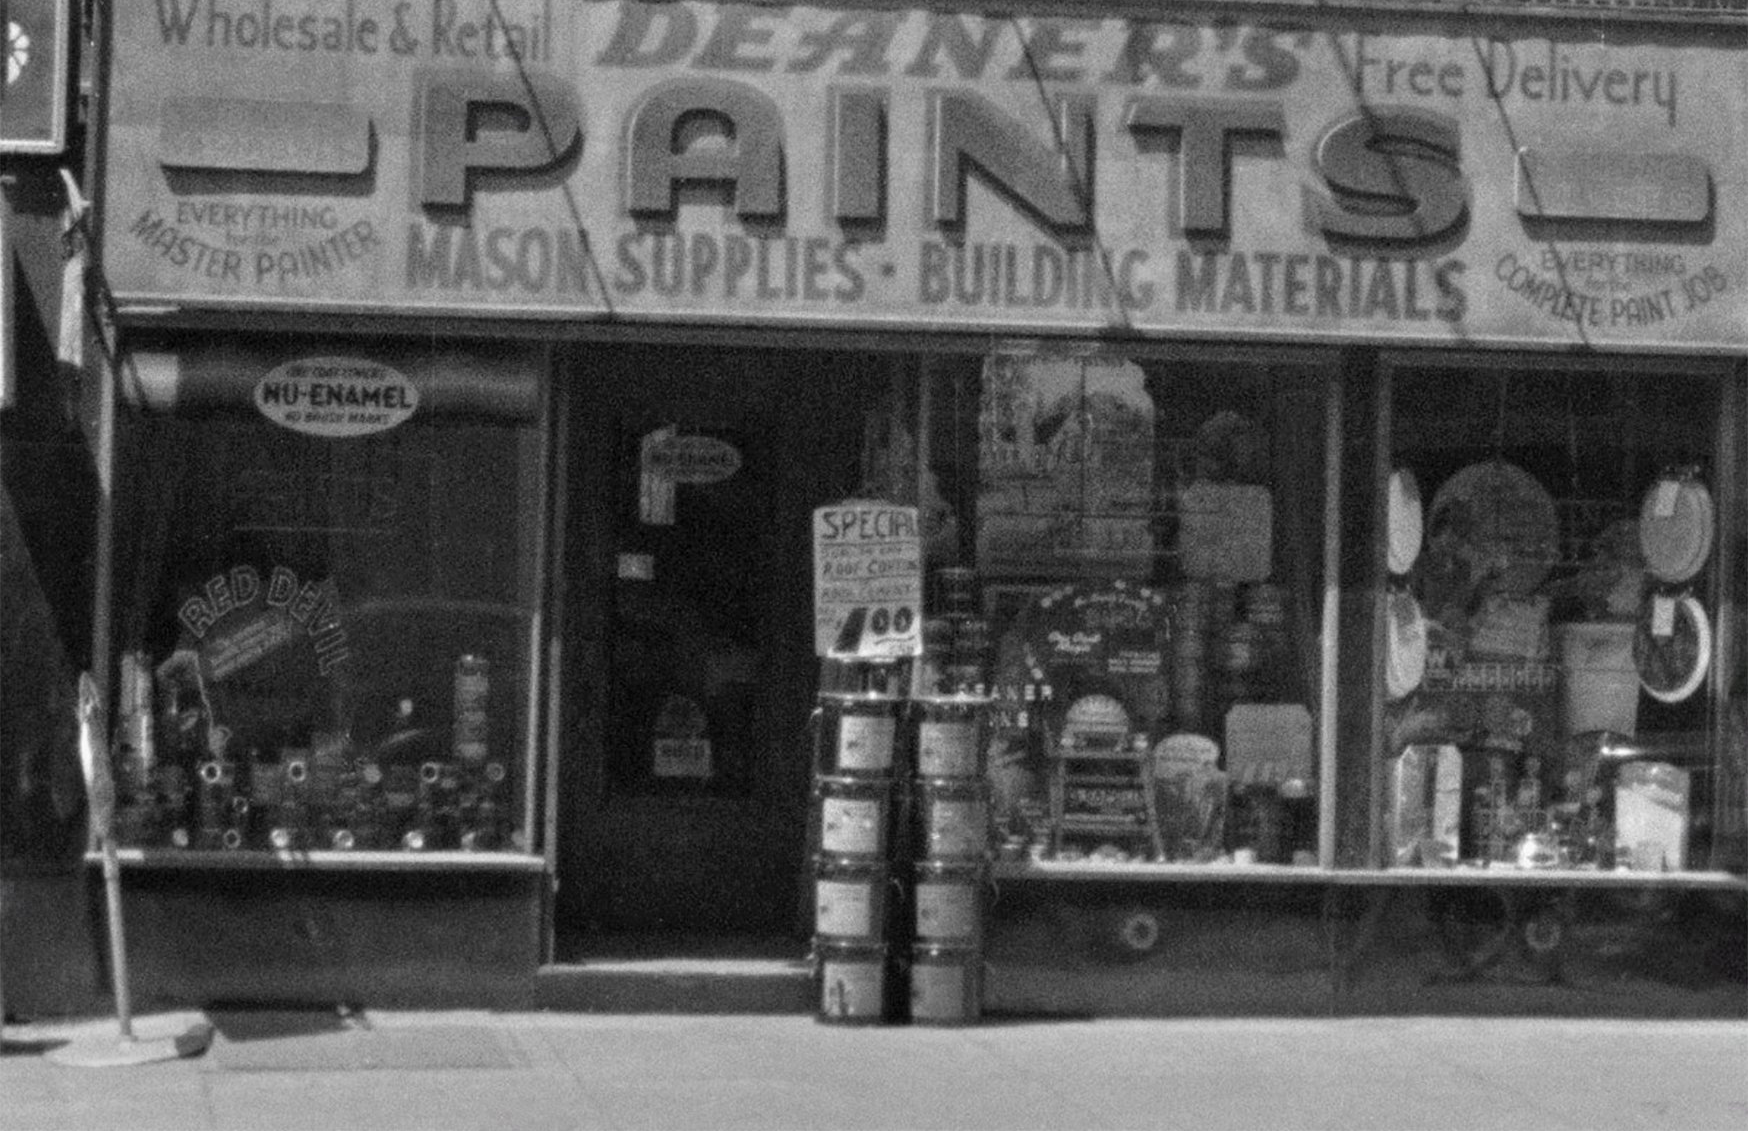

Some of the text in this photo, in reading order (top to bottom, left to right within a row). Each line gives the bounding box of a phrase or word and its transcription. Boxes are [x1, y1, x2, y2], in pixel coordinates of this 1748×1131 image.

[389, 0, 420, 56] &
[1356, 33, 1677, 127] Free Delivery
[409, 68, 1471, 258] PAINTS
[129, 209, 381, 283] MASTER PAINTER
[176, 201, 338, 231] EVERYTHING
[405, 222, 867, 303] MASON SUPPLIES
[917, 240, 1468, 324] BUILDING MATERIALS
[1495, 253, 1728, 326] COMPLETE PAINT JOB
[1541, 249, 1687, 276] EVERYTHING
[263, 381, 412, 410] NU-ENAMEL
[178, 564, 260, 638] RED
[266, 564, 350, 677] DEVIL
